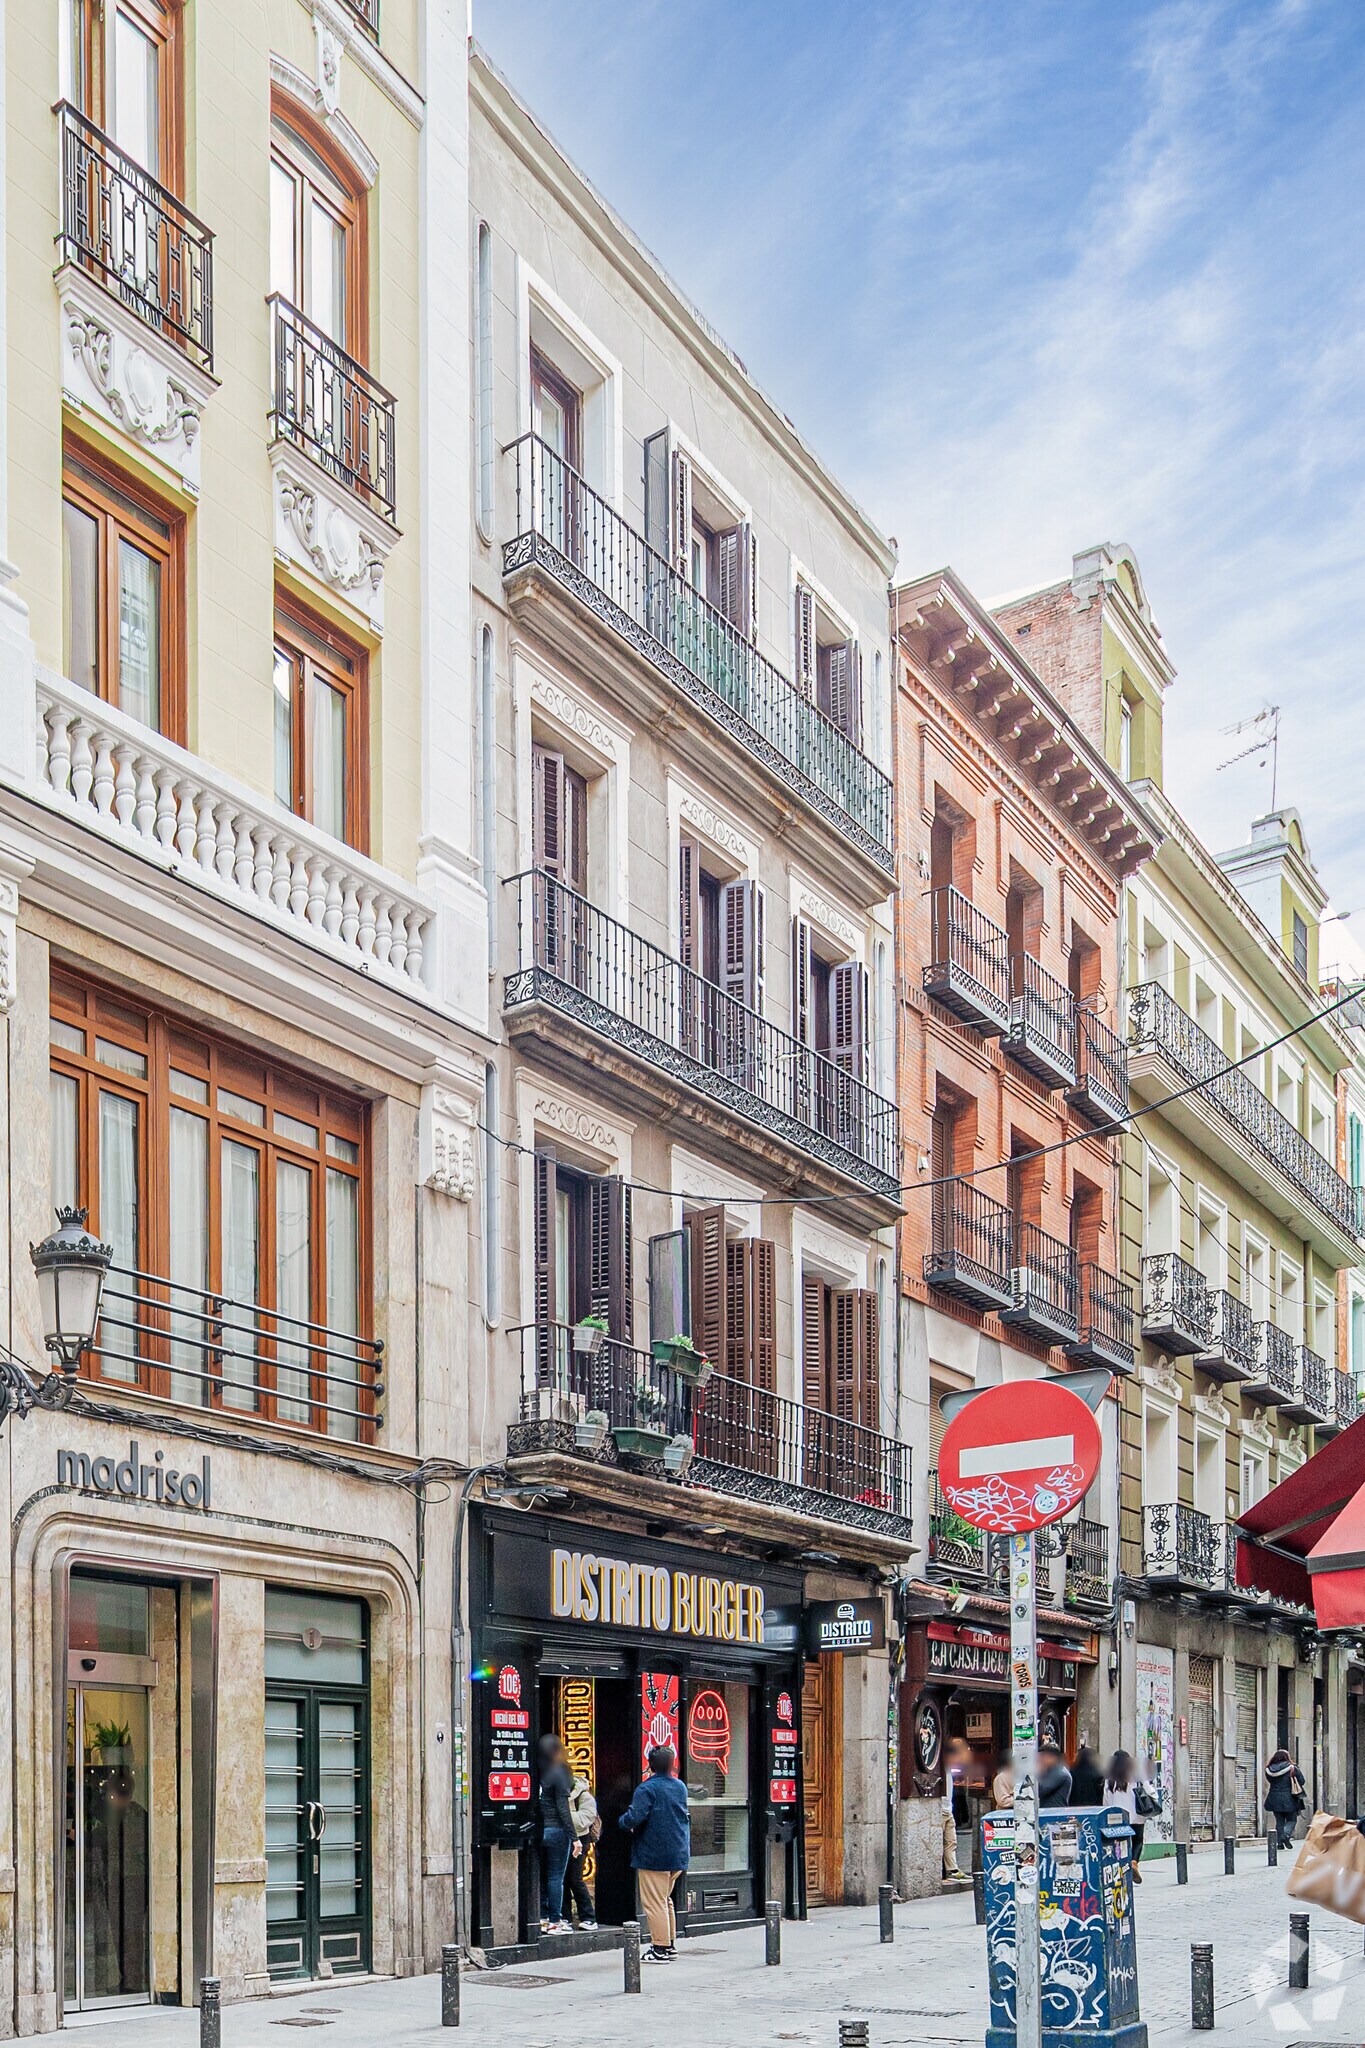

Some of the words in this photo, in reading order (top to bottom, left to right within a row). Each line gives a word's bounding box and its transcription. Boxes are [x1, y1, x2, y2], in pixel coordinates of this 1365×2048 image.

[57, 1440, 211, 1509] madrisol
[551, 1548, 671, 1632] DISTRITO
[673, 1571, 765, 1643] BURGER
[821, 1620, 872, 1638] DISTRITO
[931, 1641, 947, 1667] LA
[949, 1644, 980, 1672] CASA
[982, 1648, 1006, 1675] DEL
[501, 1673, 519, 1695] 10€
[1014, 1662, 1032, 1688] TOROS
[992, 1820, 1007, 1828] VIVA
